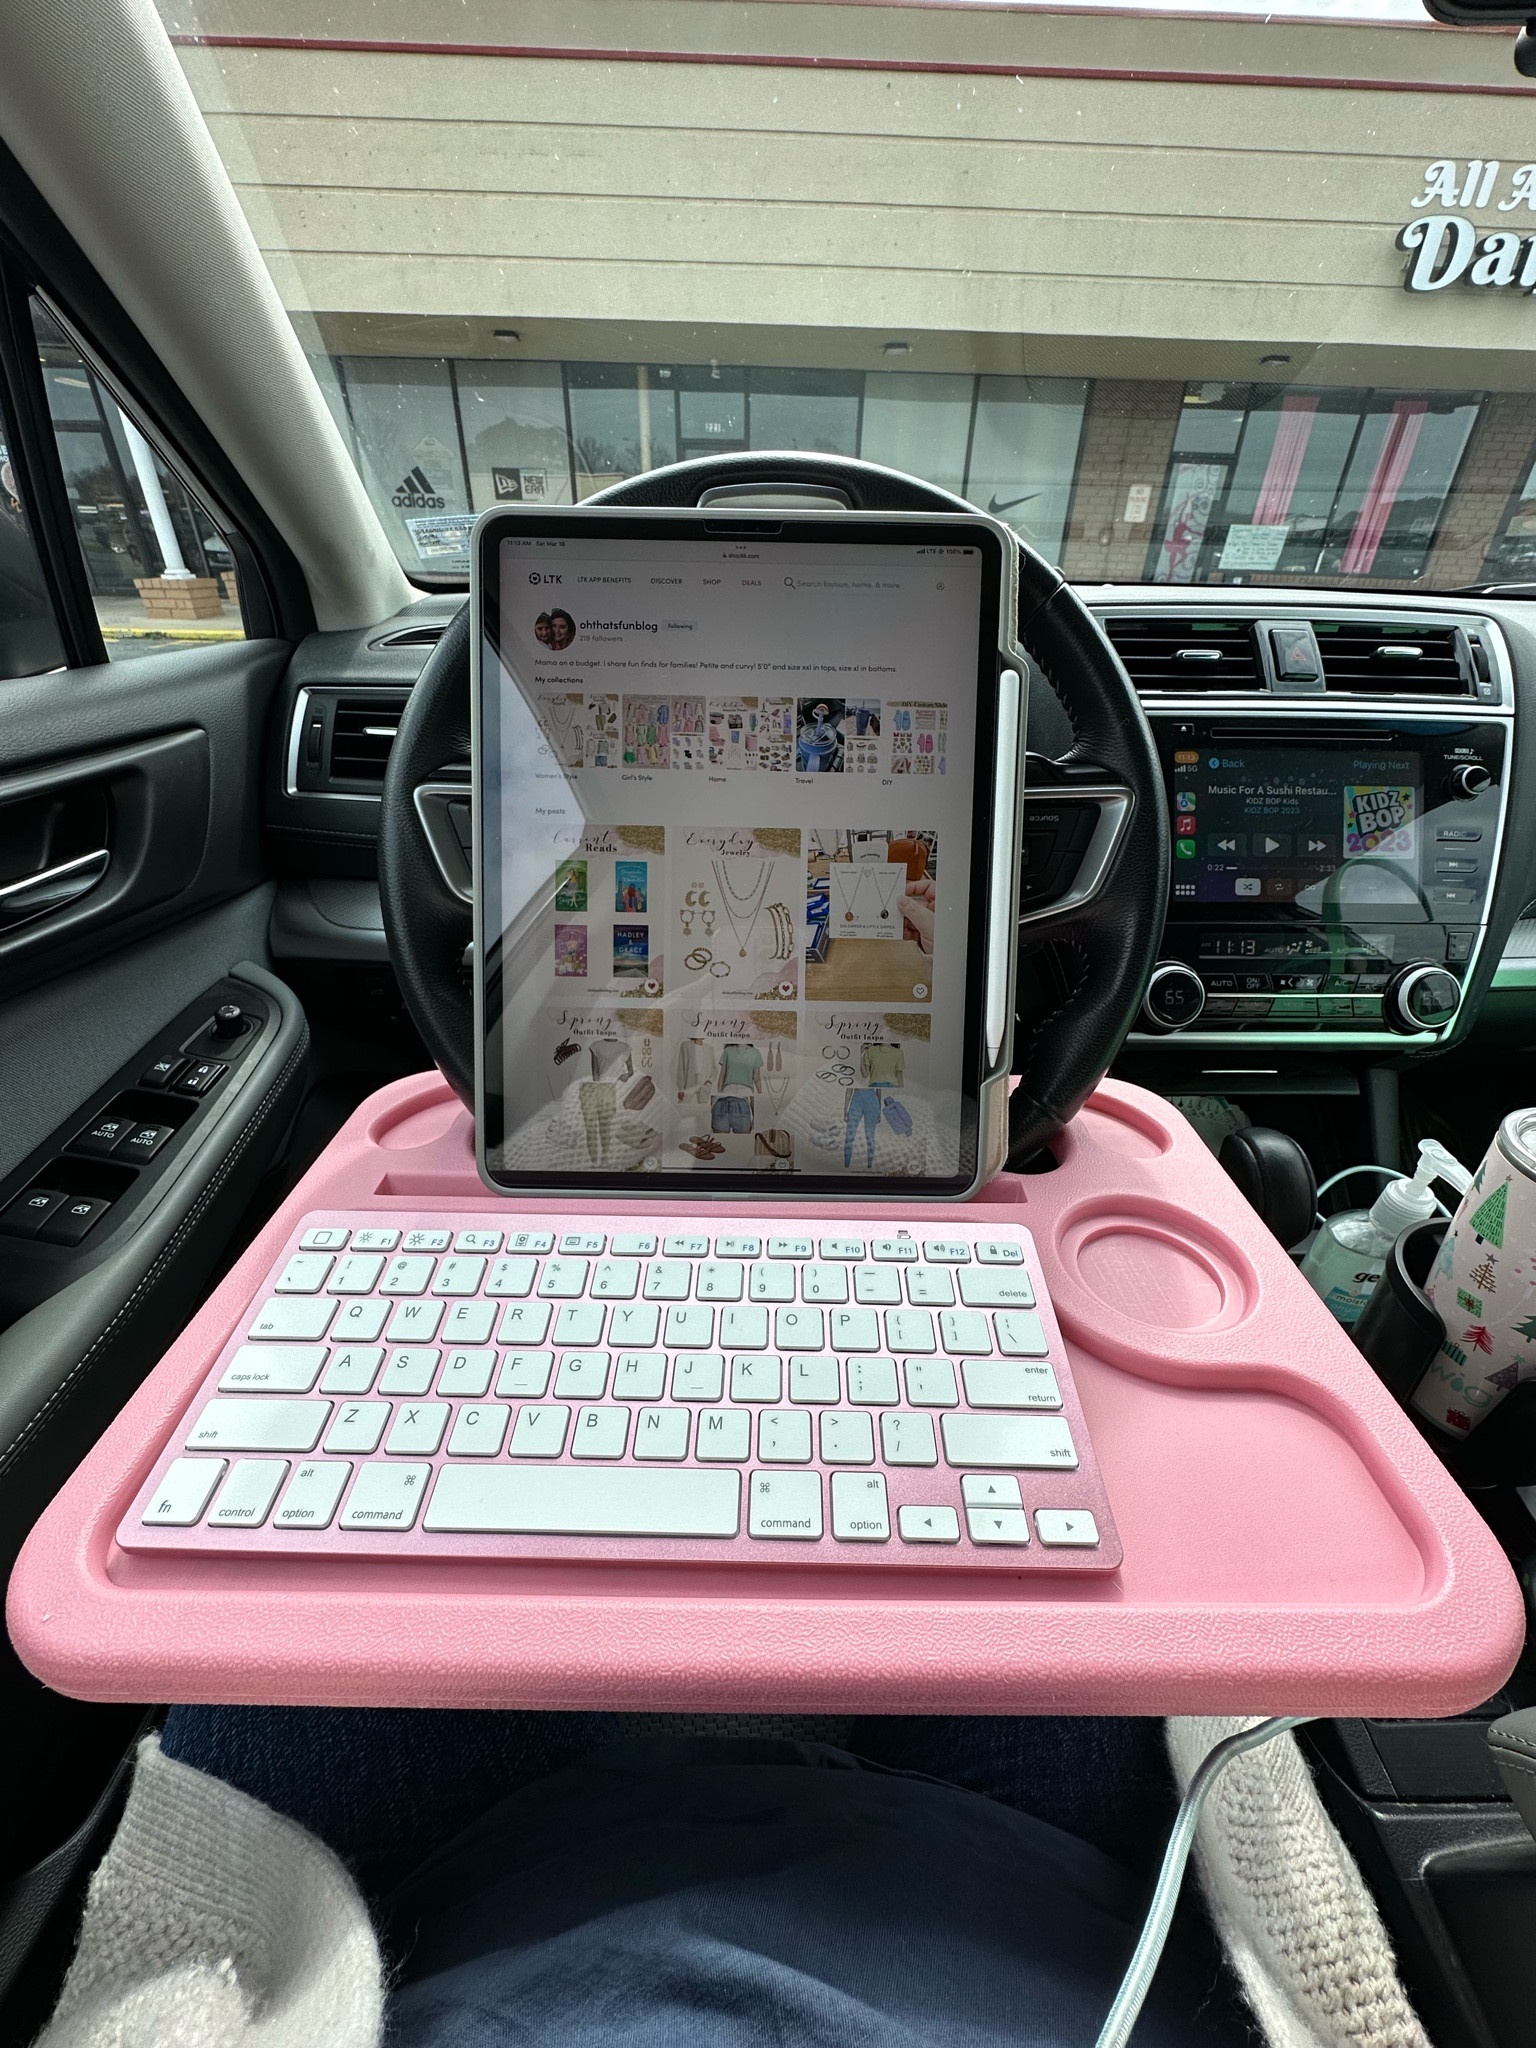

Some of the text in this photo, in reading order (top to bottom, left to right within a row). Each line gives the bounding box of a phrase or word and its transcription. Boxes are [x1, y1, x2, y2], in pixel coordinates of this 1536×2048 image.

[1410, 159, 1500, 208] All
[523, 475, 545, 485] NEW
[524, 485, 545, 495] ERA
[391, 493, 446, 509] adidas
[543, 575, 563, 584] LTK
[602, 576, 632, 584] BENEFITS
[650, 577, 683, 585] DISCOVER
[702, 578, 722, 586] SHOP
[741, 579, 762, 587] DEALS
[579, 620, 658, 633] ohthatsfunblog
[591, 634, 623, 642] followers
[534, 659, 558, 667] Mama
[606, 660, 627, 668] share
[627, 660, 639, 668] fun
[640, 660, 657, 668] finds
[658, 661, 669, 669] for
[669, 661, 699, 669] families!
[719, 662, 734, 670] and
[734, 663, 757, 672] curvy!
[771, 663, 786, 671] and
[787, 663, 801, 671] size
[801, 663, 812, 671] xxl
[534, 676, 584, 685] My collections
[1222, 758, 1246, 768] Back
[1352, 759, 1410, 771] Playing Next
[621, 773, 653, 782] Girl's Style
[795, 777, 814, 785] Travel
[881, 778, 893, 786] DIY
[1208, 785, 1237, 795] Music
[1238, 786, 1256, 795] For
[1256, 786, 1265, 795] A
[1266, 785, 1293, 796] Sushi
[1245, 797, 1299, 806] KIDZ BOP Kids
[1353, 790, 1401, 814] KIDZ
[535, 807, 566, 816] My posts
[1244, 806, 1300, 815] KIDZ BOP 2023
[1358, 806, 1406, 835] BOP
[1346, 829, 1412, 852] 2023
[585, 844, 618, 853] Reads
[721, 849, 751, 858] Jewelry
[1207, 864, 1224, 872] 0:22
[617, 931, 645, 939] HADLEY
[618, 946, 643, 954] GRACE
[1215, 939, 1257, 955] 11:13
[1210, 979, 1233, 987] AUTO
[558, 1010, 612, 1031] Spring
[690, 1011, 746, 1034] Spring
[824, 1014, 880, 1036] Spring
[573, 1028, 594, 1036] Outfit
[730, 1031, 751, 1039] Inspo
[863, 1033, 884, 1041] Inspo
[91, 1129, 115, 1139] AUTO
[130, 1136, 154, 1146] AUTO
[350, 1306, 362, 1317] Q
[405, 1307, 421, 1318] W
[457, 1308, 469, 1319] E
[511, 1309, 523, 1320] R
[568, 1310, 578, 1320] T
[623, 1311, 633, 1322] Y
[676, 1312, 686, 1323] U
[786, 1314, 798, 1325] O
[841, 1315, 850, 1326] P
[339, 1355, 350, 1367] A
[397, 1356, 409, 1368] S
[454, 1357, 466, 1369] D
[511, 1358, 523, 1370] F
[569, 1359, 582, 1371] G
[626, 1360, 638, 1372] H
[685, 1361, 692, 1373] J
[742, 1363, 752, 1375] K
[800, 1364, 809, 1376] L
[344, 1409, 359, 1422] Z
[404, 1410, 419, 1423] X
[466, 1411, 479, 1425] C
[529, 1413, 540, 1426] V
[587, 1414, 598, 1427] B
[648, 1415, 660, 1428] N
[709, 1416, 722, 1430] M
[1050, 1449, 1071, 1457] shift
[301, 1469, 314, 1477] alt
[867, 1480, 879, 1488] alt
[158, 1500, 171, 1513] fn
[219, 1508, 255, 1517] control
[282, 1509, 314, 1519] option
[352, 1510, 403, 1519] command
[761, 1518, 810, 1528] command
[850, 1520, 882, 1531] option
